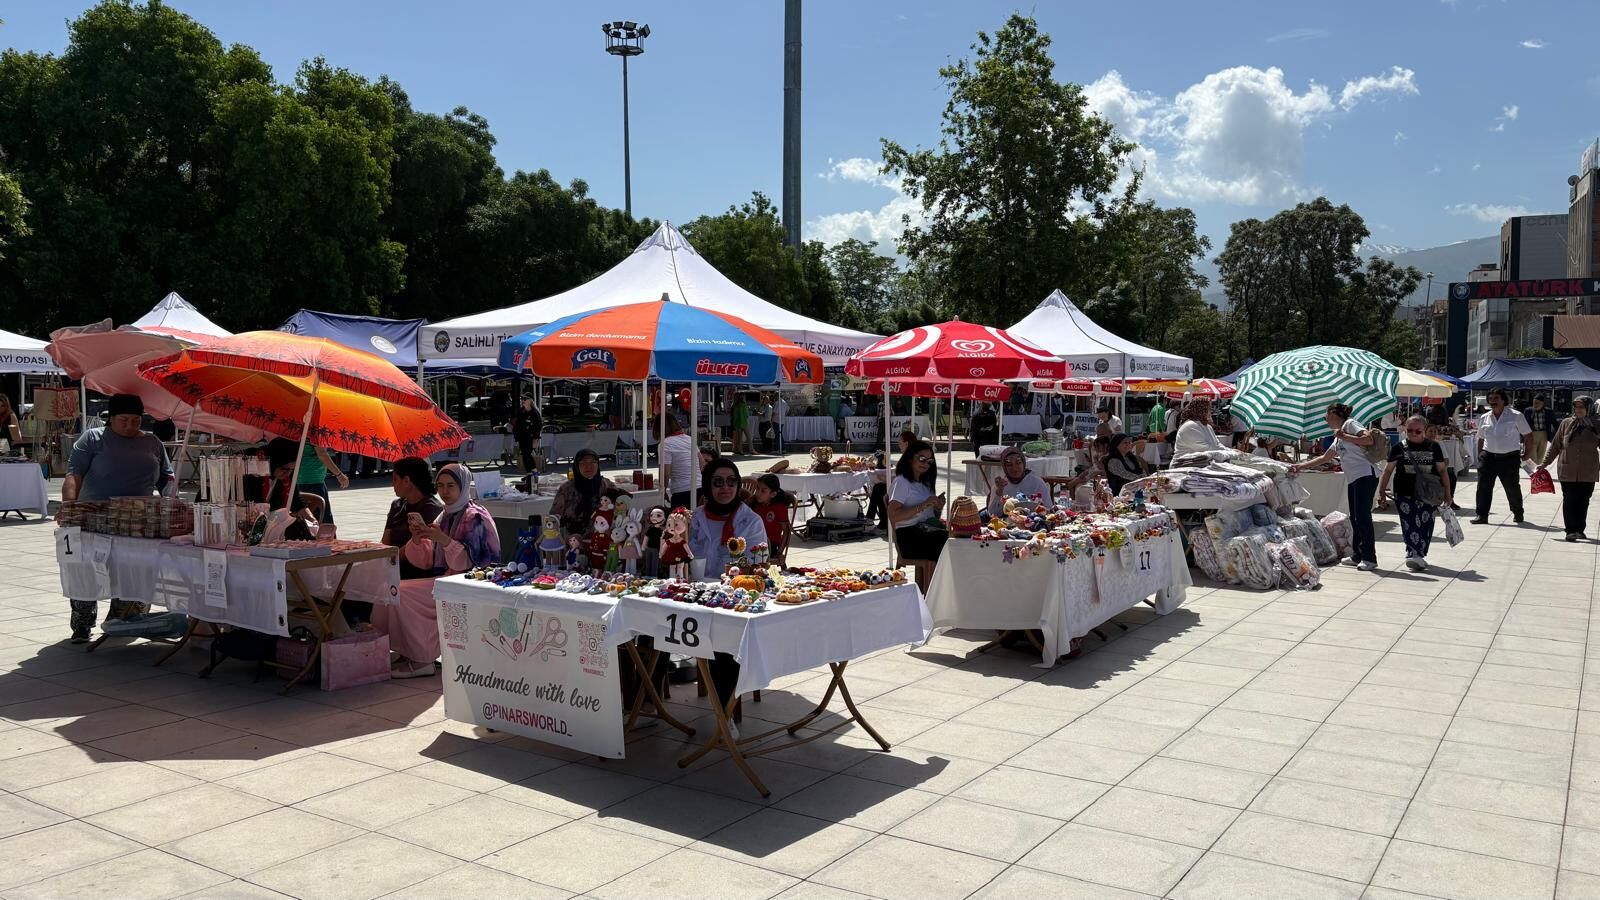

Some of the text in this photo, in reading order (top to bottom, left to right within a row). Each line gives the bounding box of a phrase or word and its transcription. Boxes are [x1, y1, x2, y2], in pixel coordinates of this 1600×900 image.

[1477, 280, 1584, 297] ATATÜRK
[455, 333, 494, 348] SALİHLİ
[805, 342, 816, 353] VE
[817, 343, 844, 356] SANAYİ
[16, 356, 47, 365] ODASI
[576, 349, 611, 363] Golf
[695, 359, 749, 377] ÜLKER
[1069, 362, 1090, 371] DASI
[984, 386, 1001, 399] Golf
[63, 534, 73, 555] 1
[1139, 550, 1151, 571] 17
[664, 613, 700, 648] 18
[454, 664, 601, 713] Handmade with love
[482, 702, 573, 737] @PINARSWORLD_
